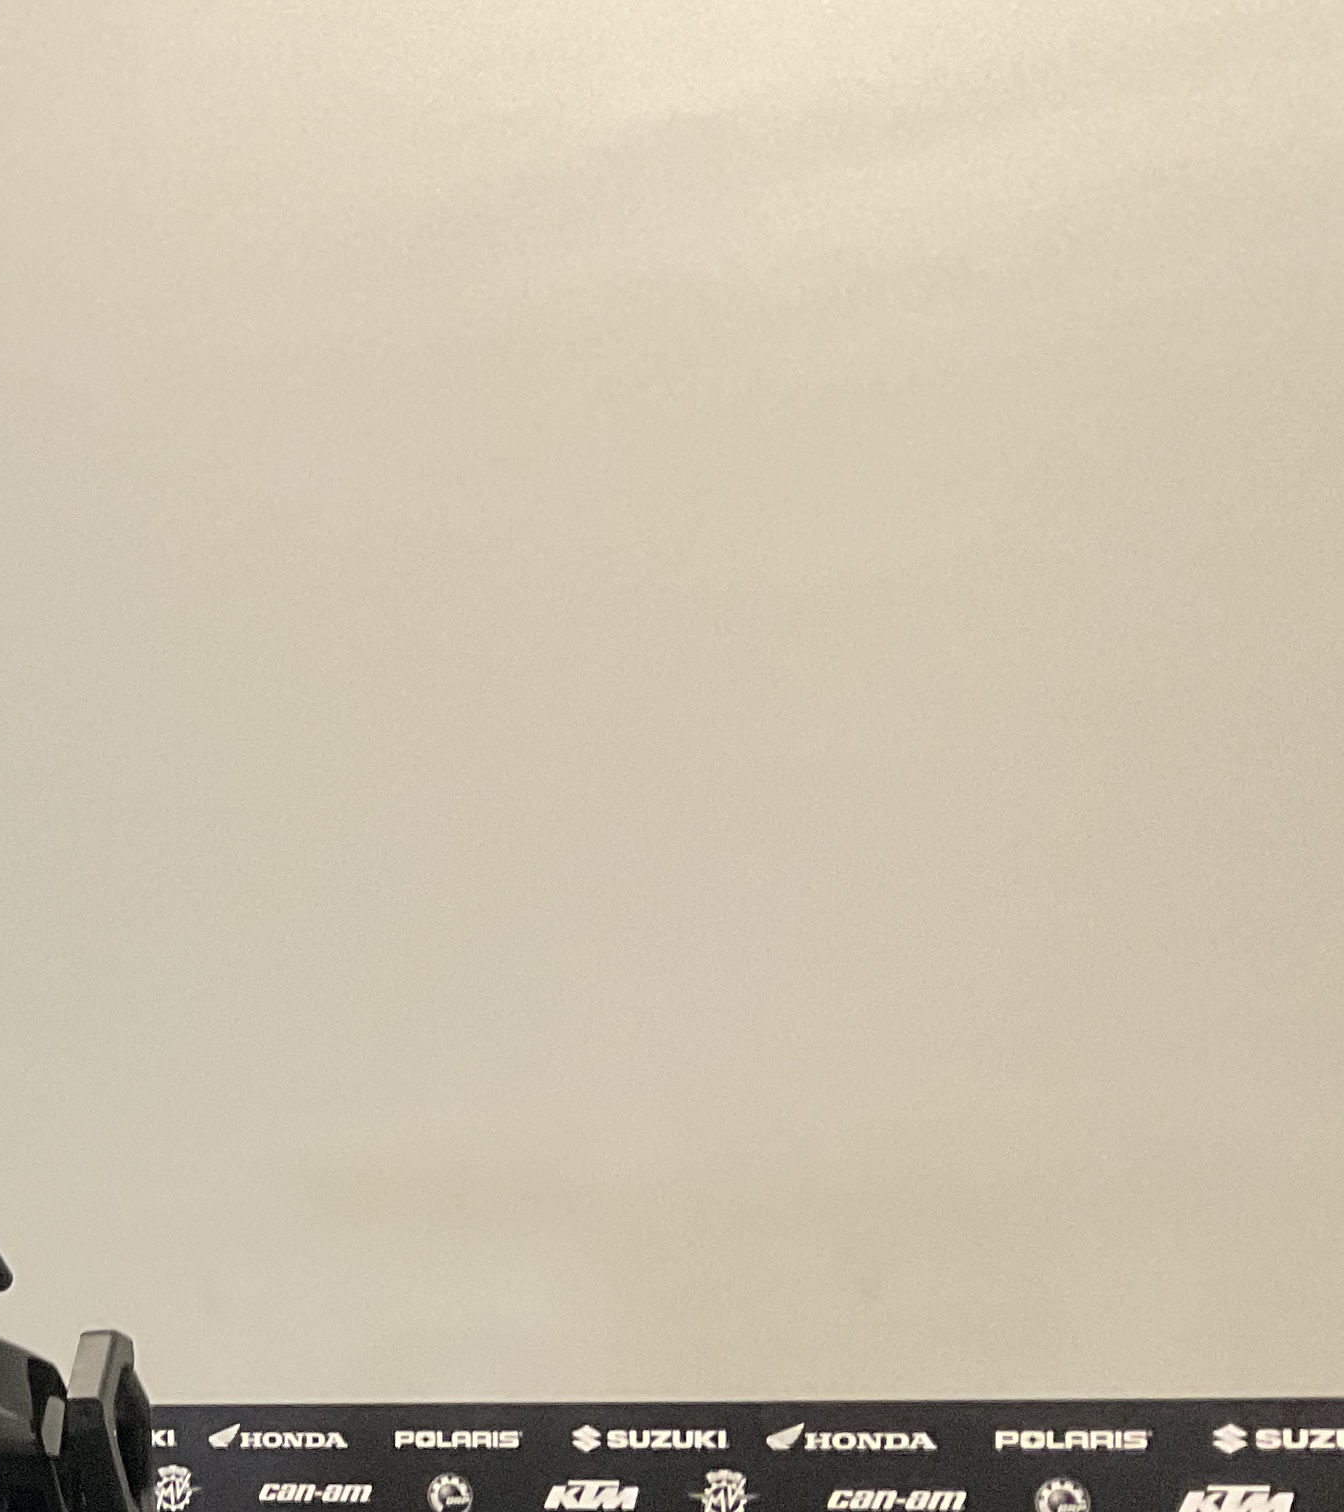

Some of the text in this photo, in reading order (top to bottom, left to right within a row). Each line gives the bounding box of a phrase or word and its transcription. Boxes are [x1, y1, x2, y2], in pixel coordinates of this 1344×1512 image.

[239, 1431, 349, 1450] HONDA
[394, 1429, 521, 1450] POLARIS
[606, 1429, 729, 1450] SUZUKI
[803, 1431, 938, 1452] HONDA
[994, 1429, 1150, 1452] POLARIS
[258, 1482, 373, 1504] can-am
[543, 1479, 640, 1512] KTM
[826, 1489, 967, 1512] can-am
